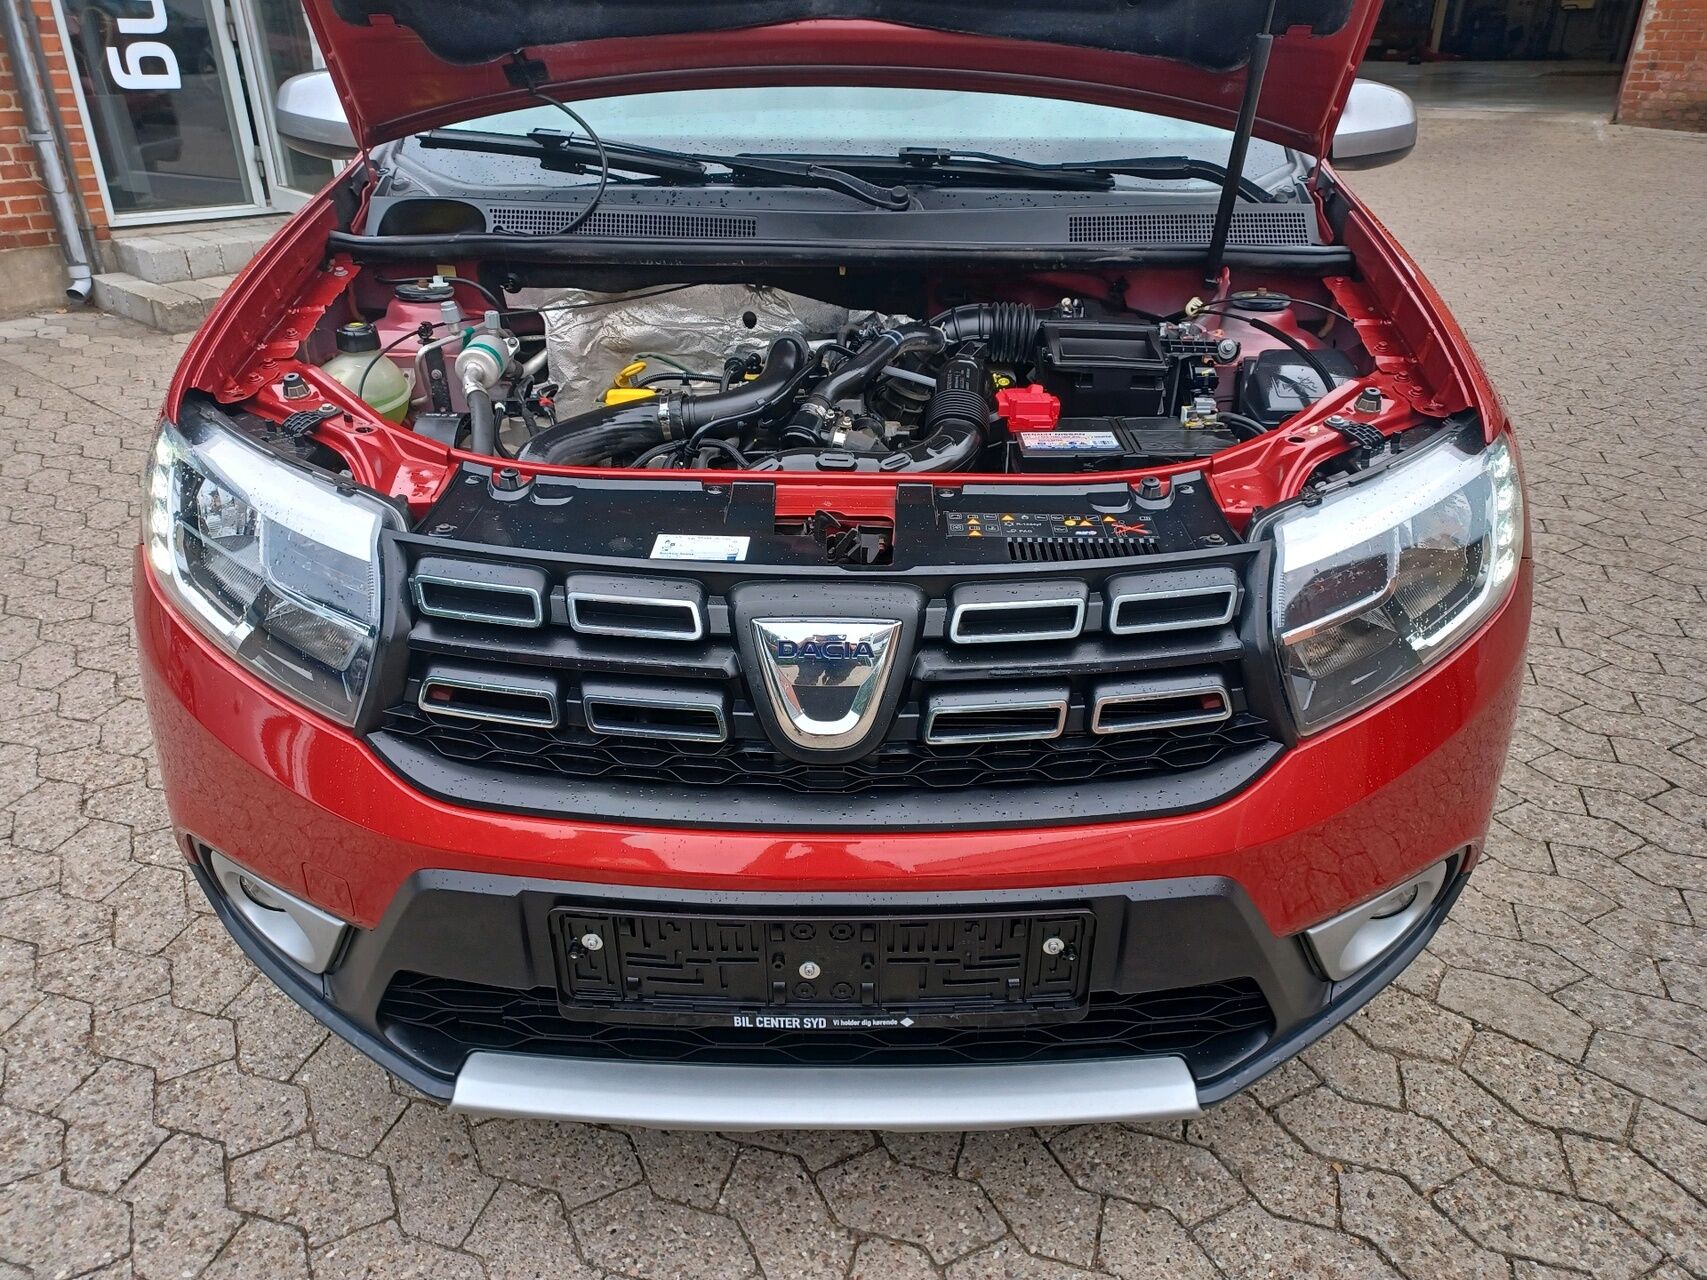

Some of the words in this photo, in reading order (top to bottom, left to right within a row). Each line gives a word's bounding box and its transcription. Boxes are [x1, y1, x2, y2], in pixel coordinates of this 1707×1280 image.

[777, 640, 876, 660] DACIA
[733, 1016, 753, 1027] BIL
[756, 1017, 800, 1029] CENTER
[803, 1017, 827, 1029] SYD
[861, 1019, 872, 1027] dig
